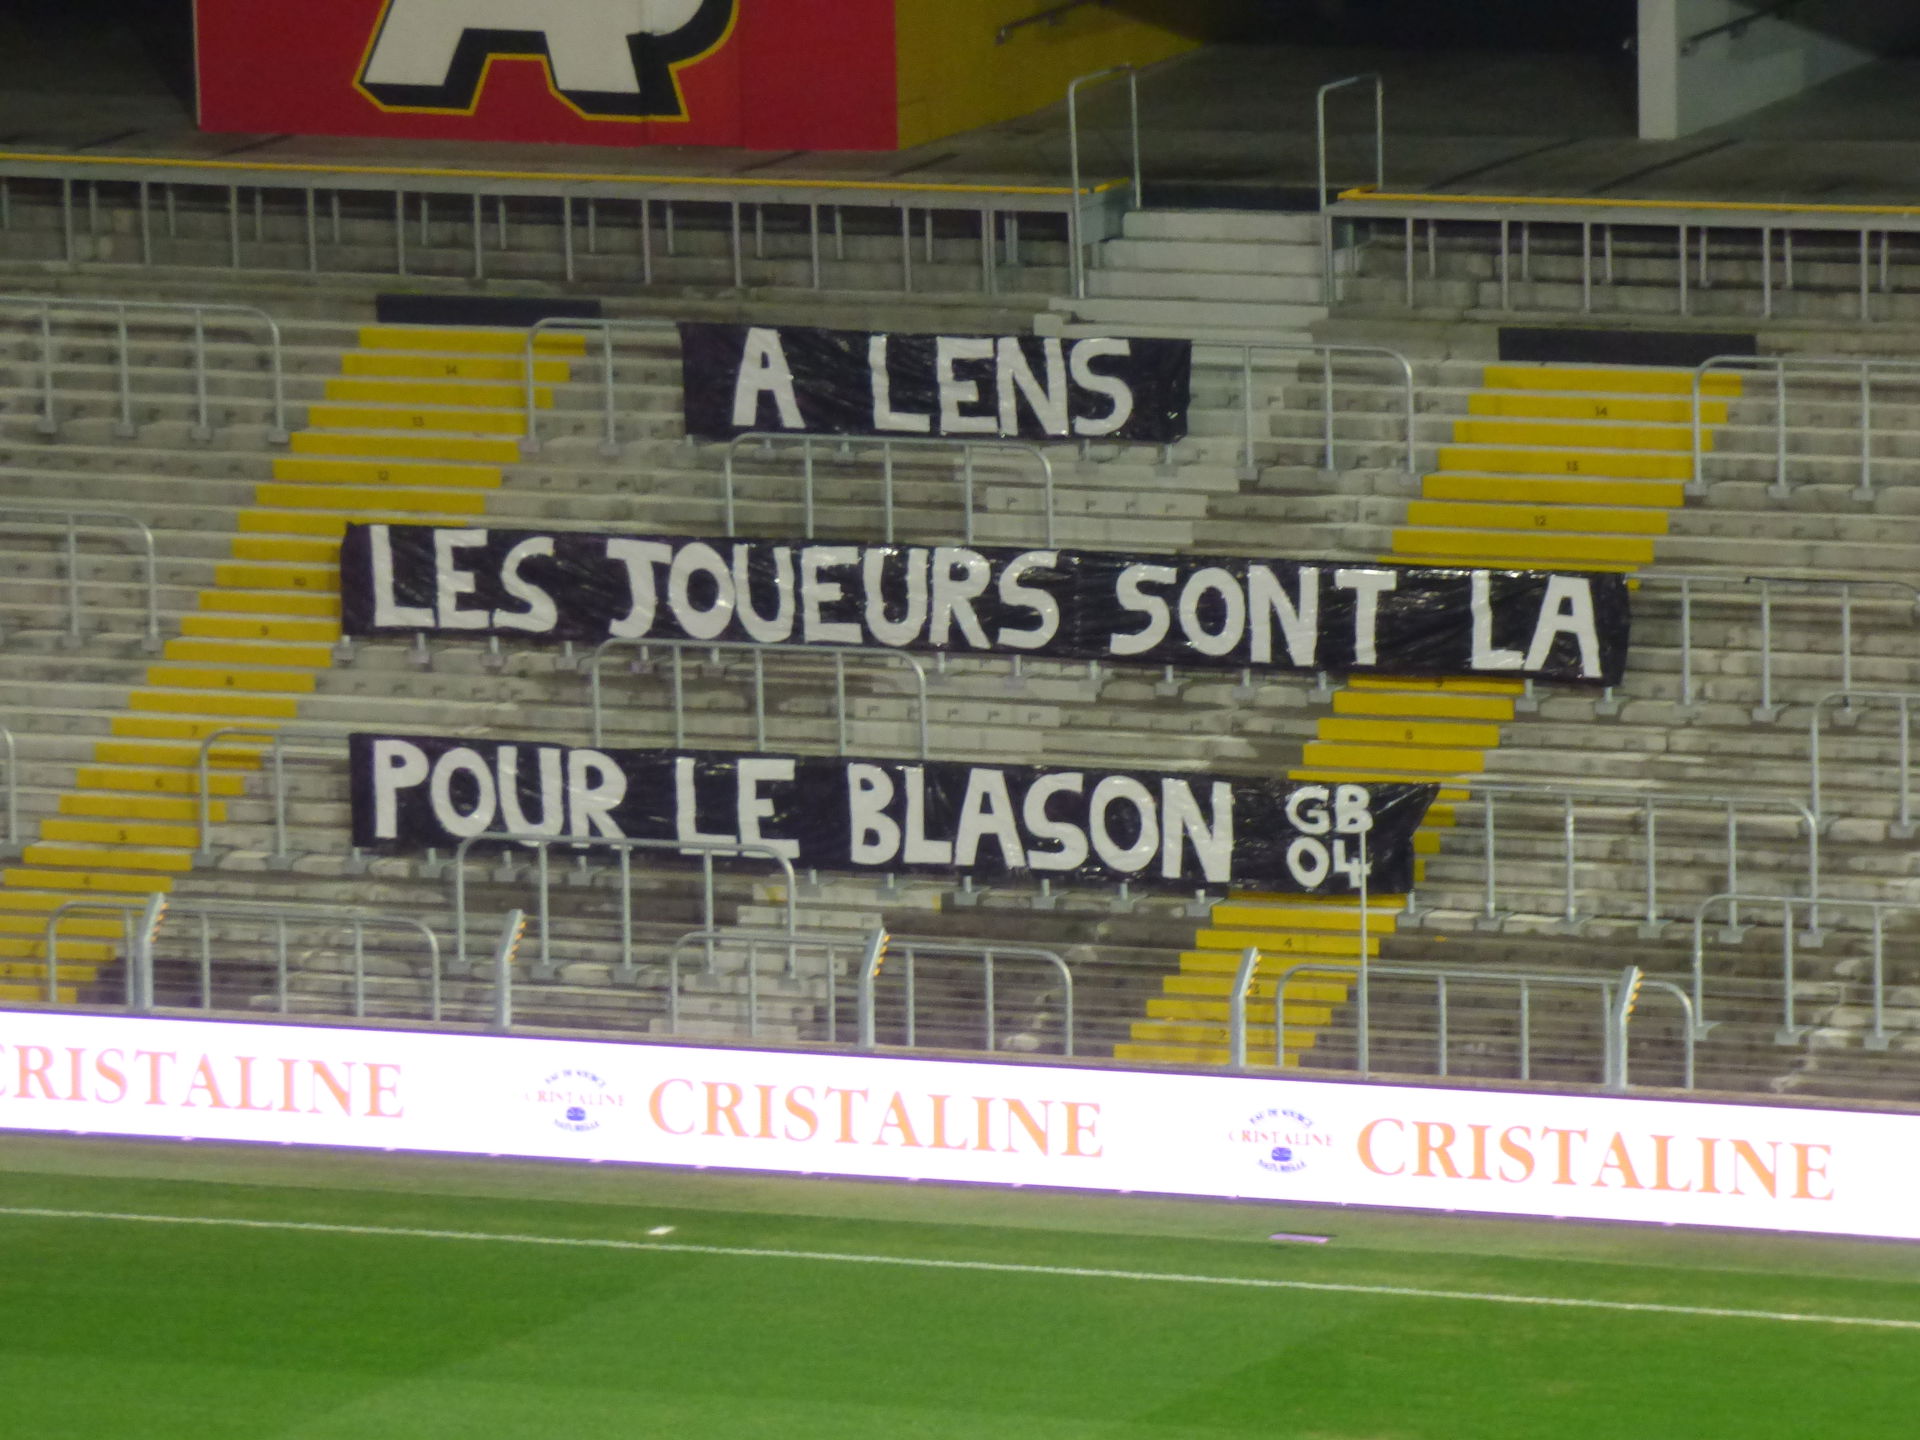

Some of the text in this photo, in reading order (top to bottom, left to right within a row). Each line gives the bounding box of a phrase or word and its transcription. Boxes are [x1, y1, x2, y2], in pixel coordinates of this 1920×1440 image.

[732, 327, 1134, 437] A LENS
[369, 524, 1602, 678] LES JOUEURS SONT LA
[373, 739, 1233, 883] POUR LE BLASON
[1285, 784, 1374, 836] GB
[0, 1043, 405, 1119] RISTALINE
[648, 1078, 1104, 1159] CRISTALINE
[1356, 1117, 1834, 1201] CRISTALINE
